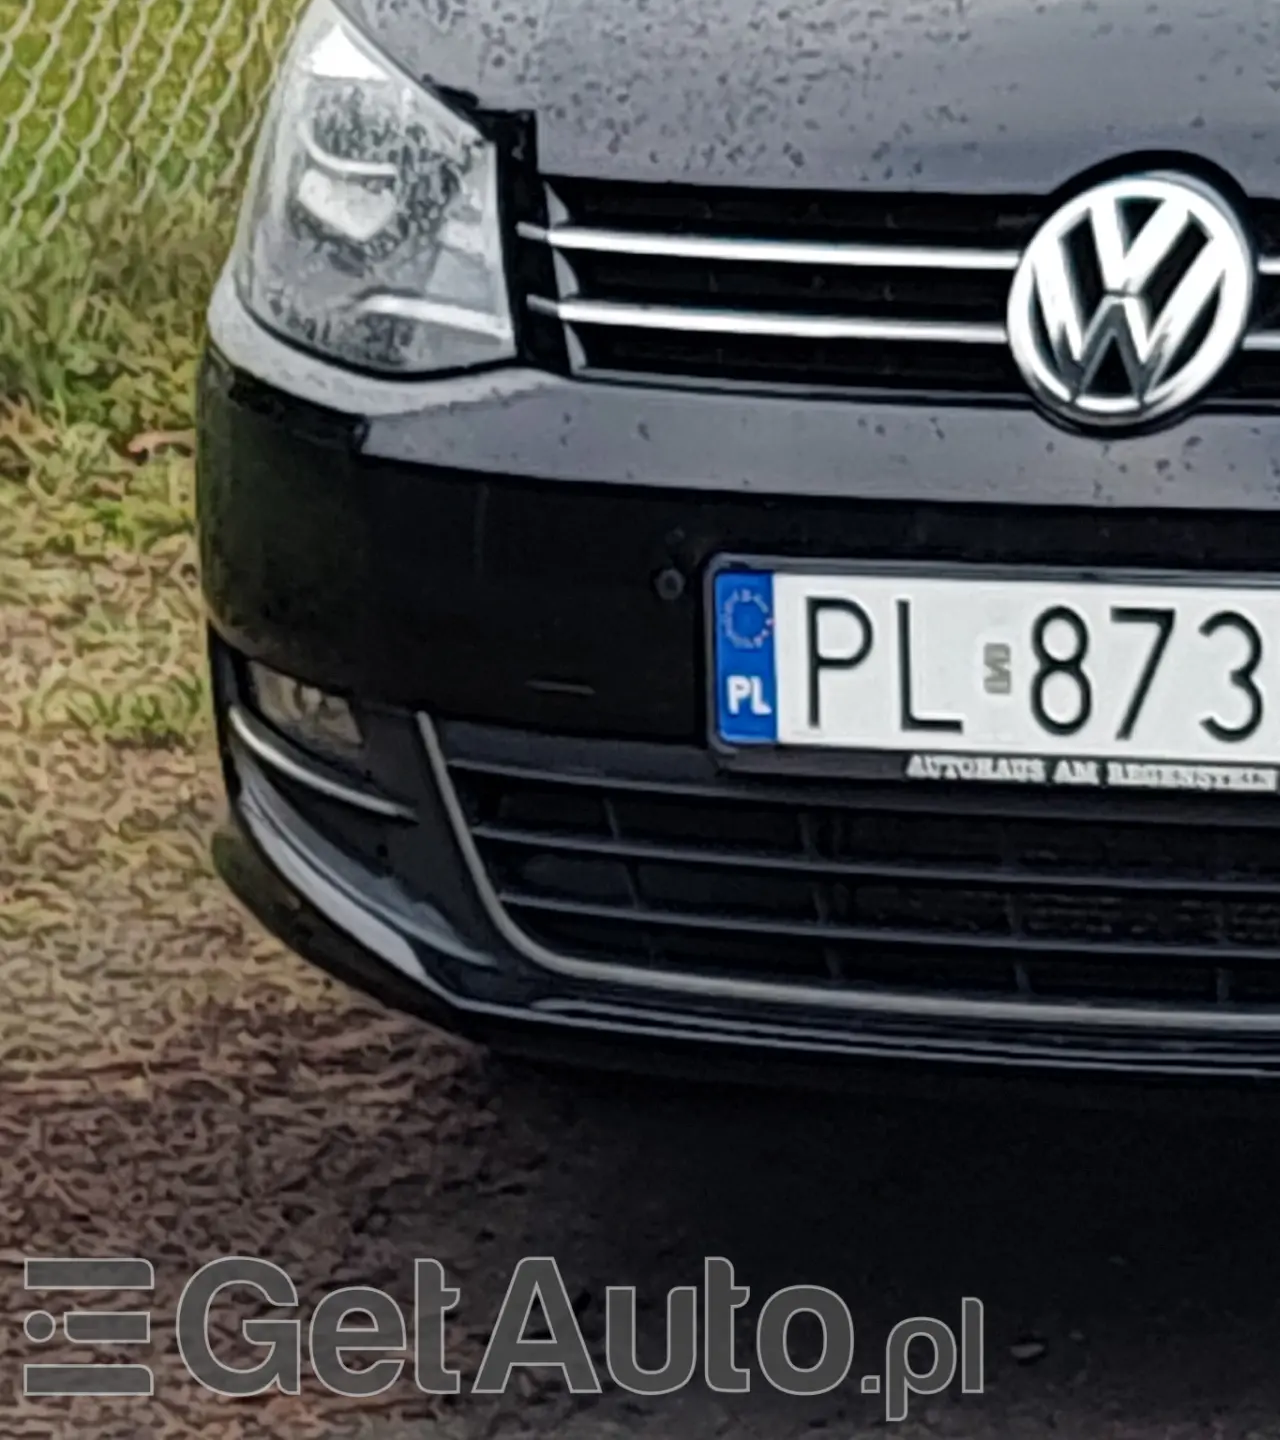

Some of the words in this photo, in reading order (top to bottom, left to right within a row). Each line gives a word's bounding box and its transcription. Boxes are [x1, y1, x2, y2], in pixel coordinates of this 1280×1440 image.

[1015, 180, 1246, 410] VW
[727, 675, 772, 715] PL
[806, 597, 963, 733] PL
